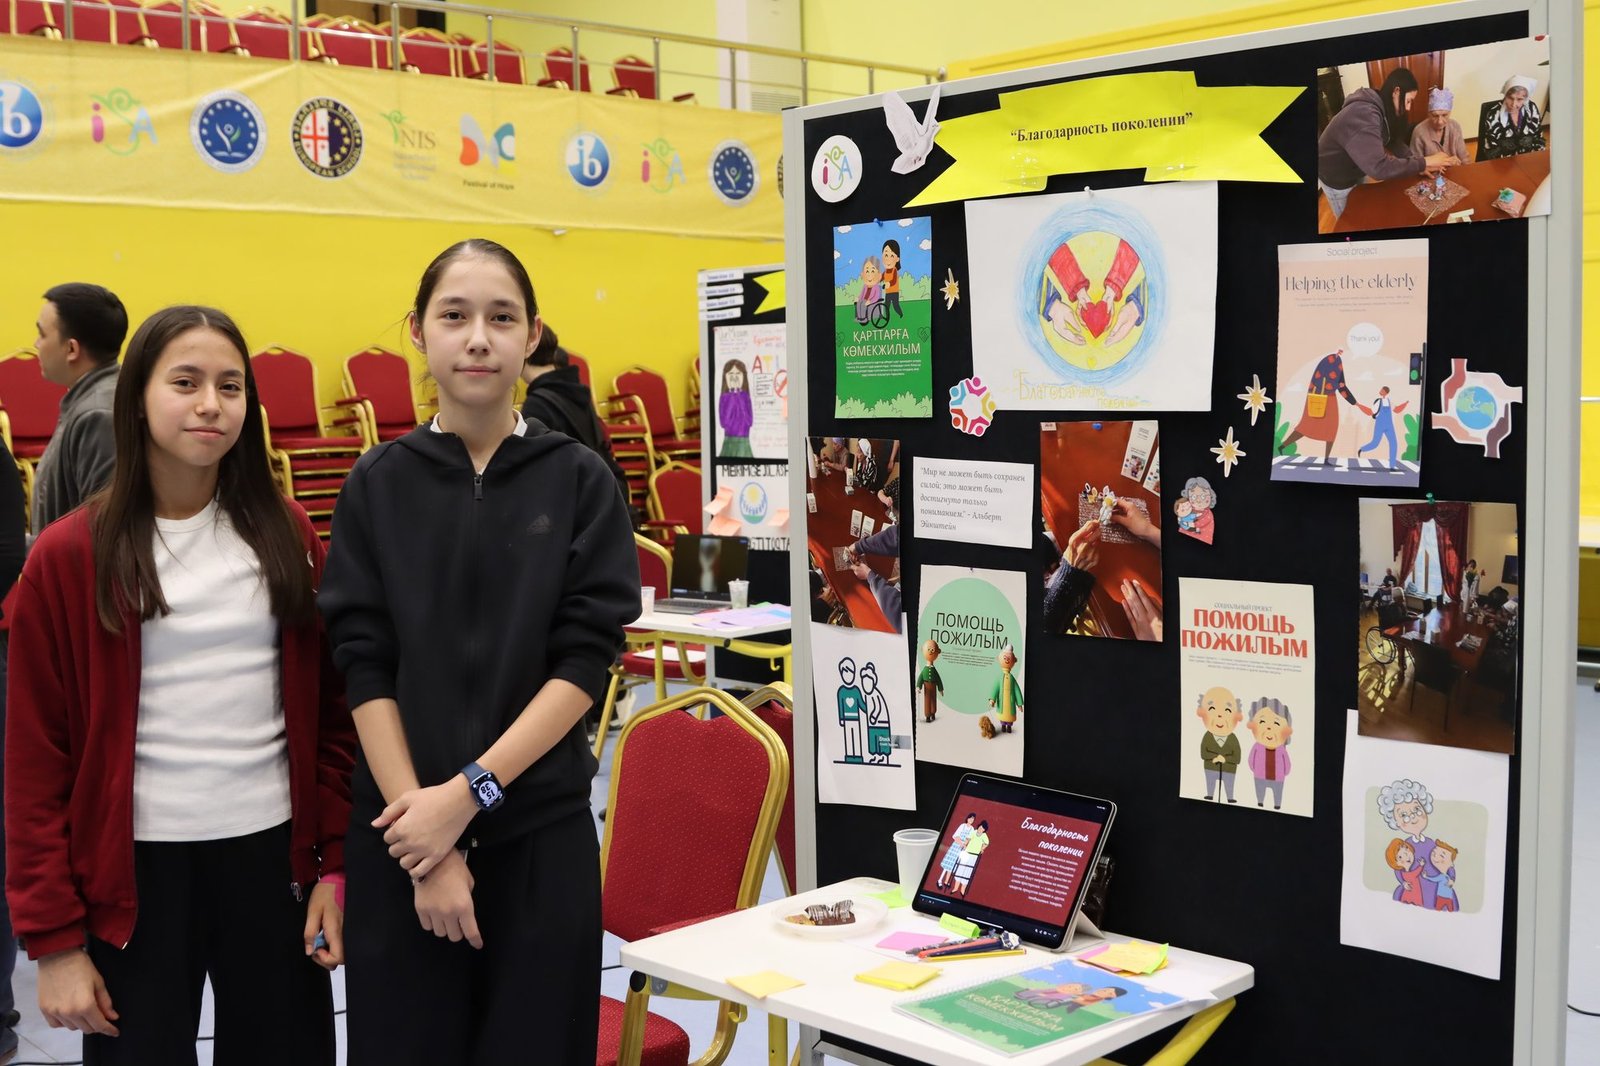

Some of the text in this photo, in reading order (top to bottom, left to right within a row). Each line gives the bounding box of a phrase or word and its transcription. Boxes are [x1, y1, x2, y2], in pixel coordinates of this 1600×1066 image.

[401, 129, 436, 149] NIS
[1327, 246, 1378, 257] Social project
[1285, 273, 1415, 294] Helping the elderly
[853, 328, 909, 344] ҚАРТТАРҒА
[843, 343, 921, 357] КӨМЕКЖИЛЫМ
[974, 470, 992, 480] быть
[994, 473, 1026, 483] сохранен
[984, 485, 1003, 494] быть
[920, 494, 961, 505] достигнуто
[972, 511, 1002, 523] Альберт
[936, 612, 1004, 635] ПОМОЩЬ
[1194, 608, 1295, 635] ПОМОЩЬ
[930, 629, 1008, 650] ПОЖИЛЫМ
[1181, 629, 1308, 658] ПОЖИЛЫМ
[480, 783, 490, 794] 38
[1021, 817, 1089, 842] Благодарность
[1038, 840, 1084, 858] поколении
